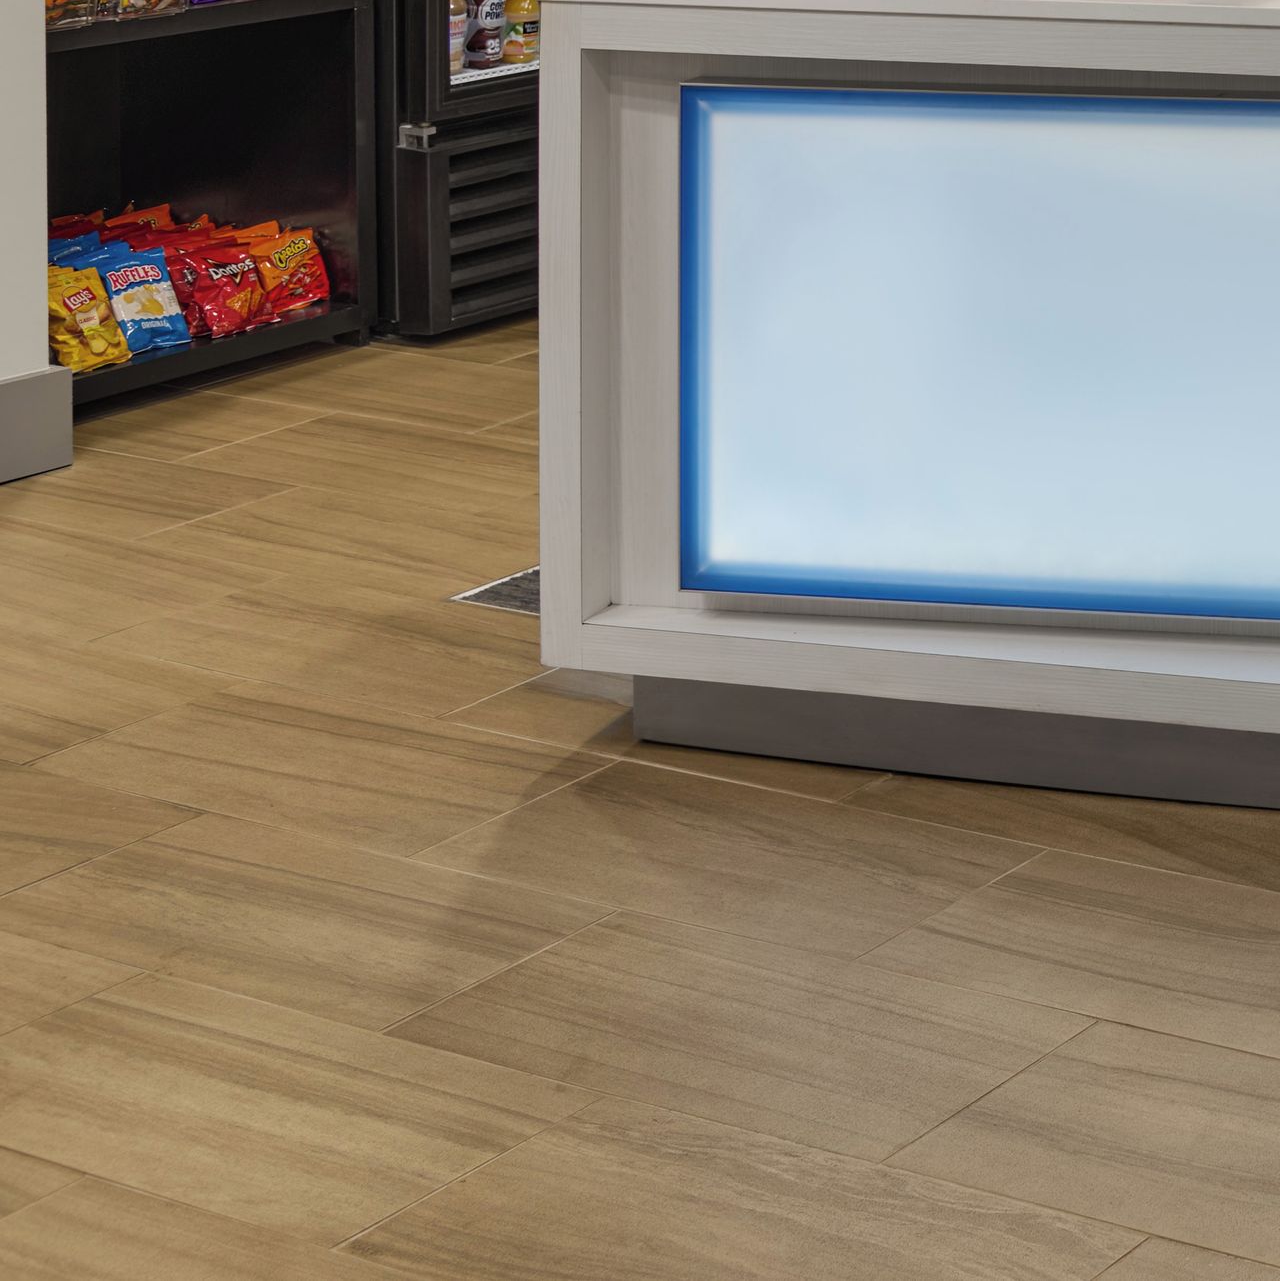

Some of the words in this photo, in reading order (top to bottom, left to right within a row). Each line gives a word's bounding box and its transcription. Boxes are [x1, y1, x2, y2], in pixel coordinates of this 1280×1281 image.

[273, 238, 308, 270] Cheetos
[107, 265, 161, 290] RUFFLES
[208, 259, 256, 280] Doritos
[64, 289, 93, 308] Lay's
